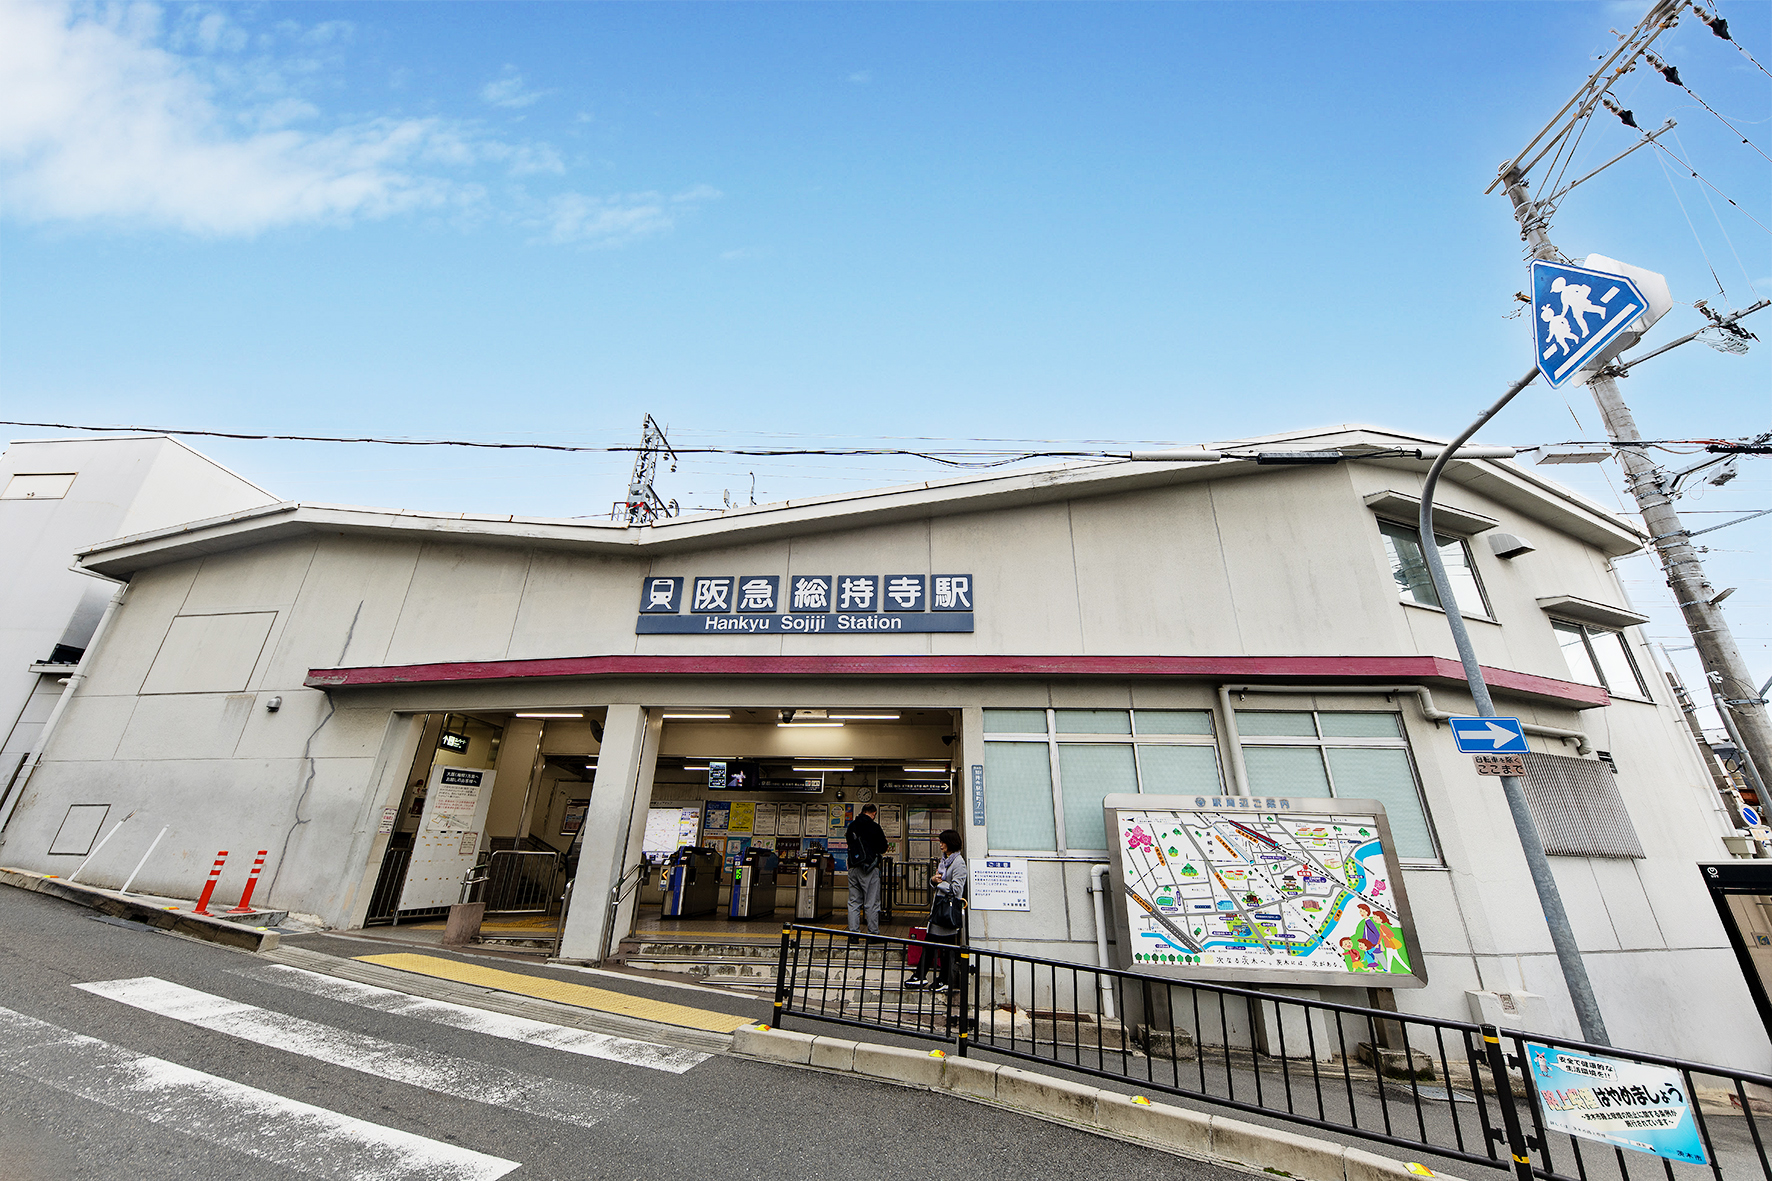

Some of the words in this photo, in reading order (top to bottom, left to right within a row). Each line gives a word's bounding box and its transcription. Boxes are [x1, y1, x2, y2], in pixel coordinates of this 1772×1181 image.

[694, 576, 971, 610] 阪急総持寺駅
[705, 616, 770, 632] Hankyu
[780, 615, 826, 632] Sojiji
[837, 614, 902, 630] Station
[1475, 756, 1520, 764] 自転車を除く
[1478, 764, 1524, 775] ここまで
[1212, 798, 1290, 809] 駅周辺ご案内
[1558, 1055, 1614, 1073] 安全で健康的な
[1676, 1148, 1704, 1163] 茨木市
